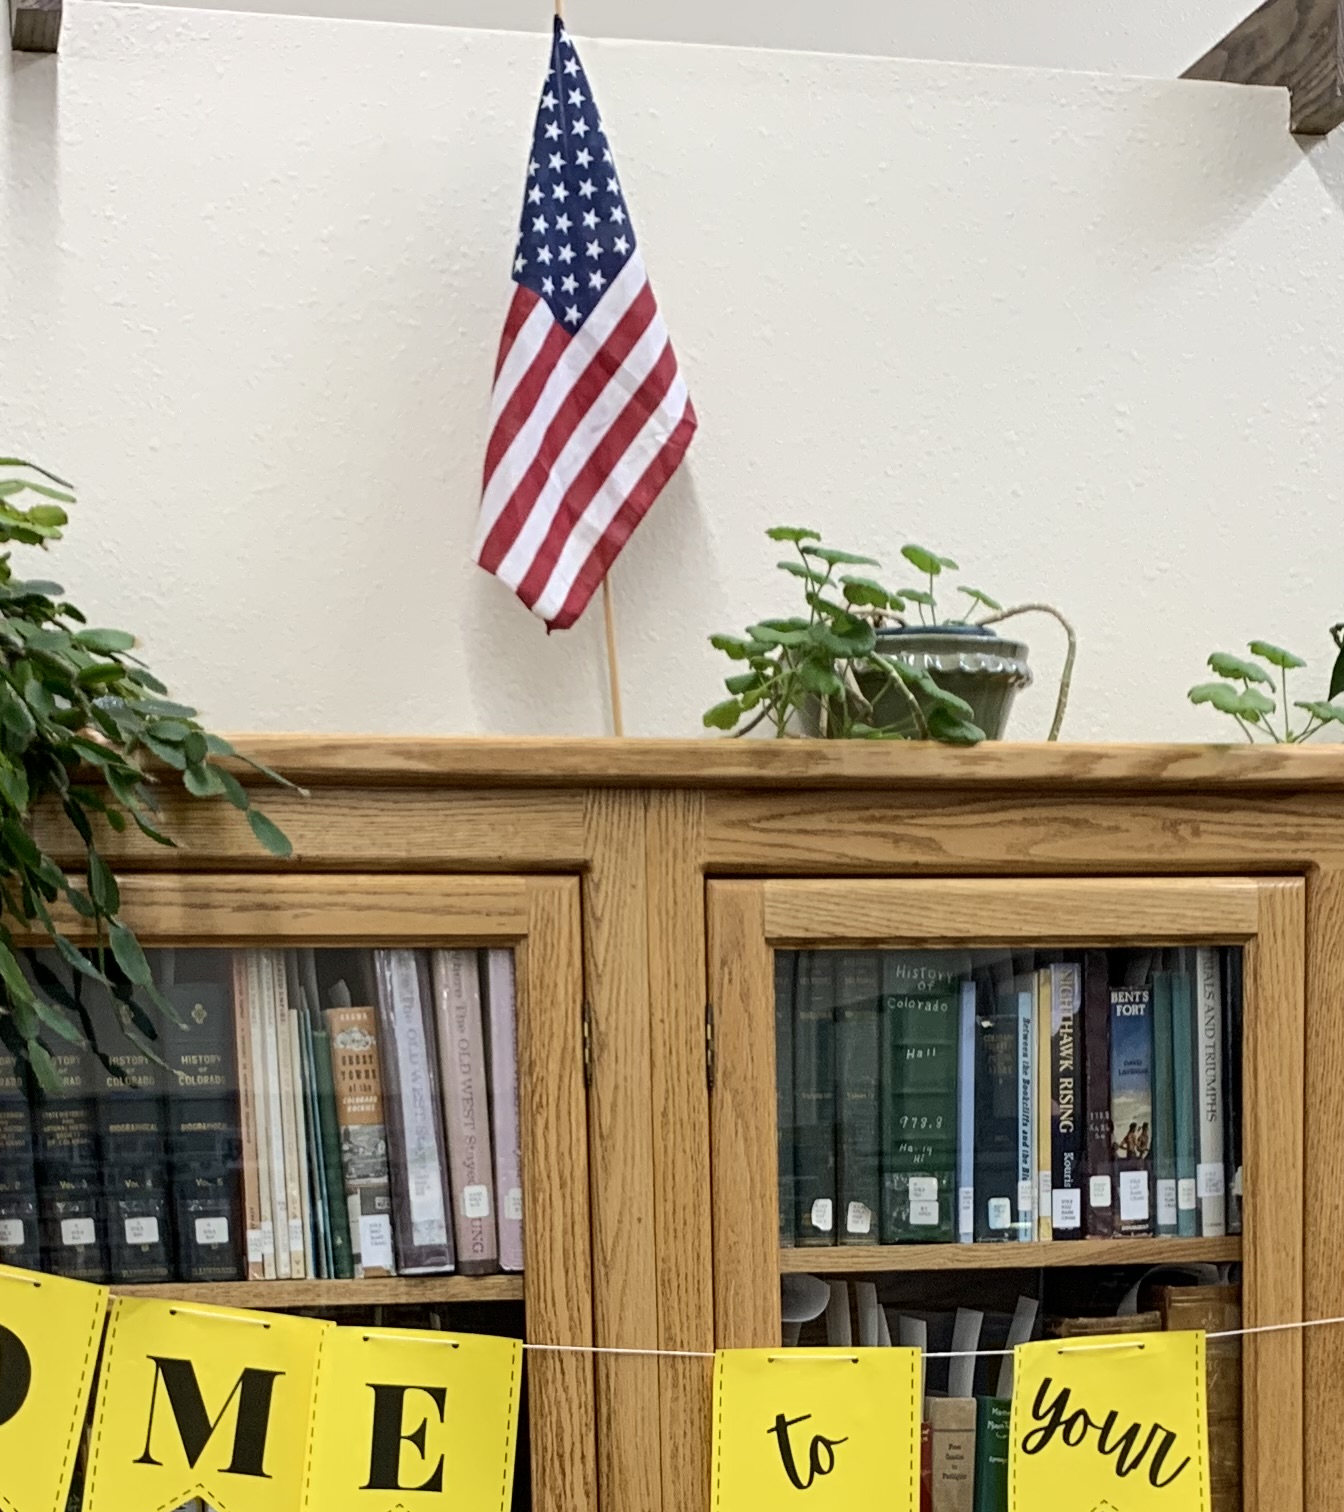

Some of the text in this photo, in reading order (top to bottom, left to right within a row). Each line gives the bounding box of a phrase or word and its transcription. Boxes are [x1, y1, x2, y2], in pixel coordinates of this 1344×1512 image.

[888, 997, 948, 1012] Colorado
[459, 1039, 472, 1073] OLD
[1059, 968, 1076, 1187] NIGHTHAWK RISING Kouris
[1204, 1040, 1217, 1122] TRIUMPHS
[460, 1079, 475, 1129] WEST
[471, 1217, 485, 1254] UNG
[767, 1412, 850, 1490] to
[1021, 1376, 1193, 1489] your
